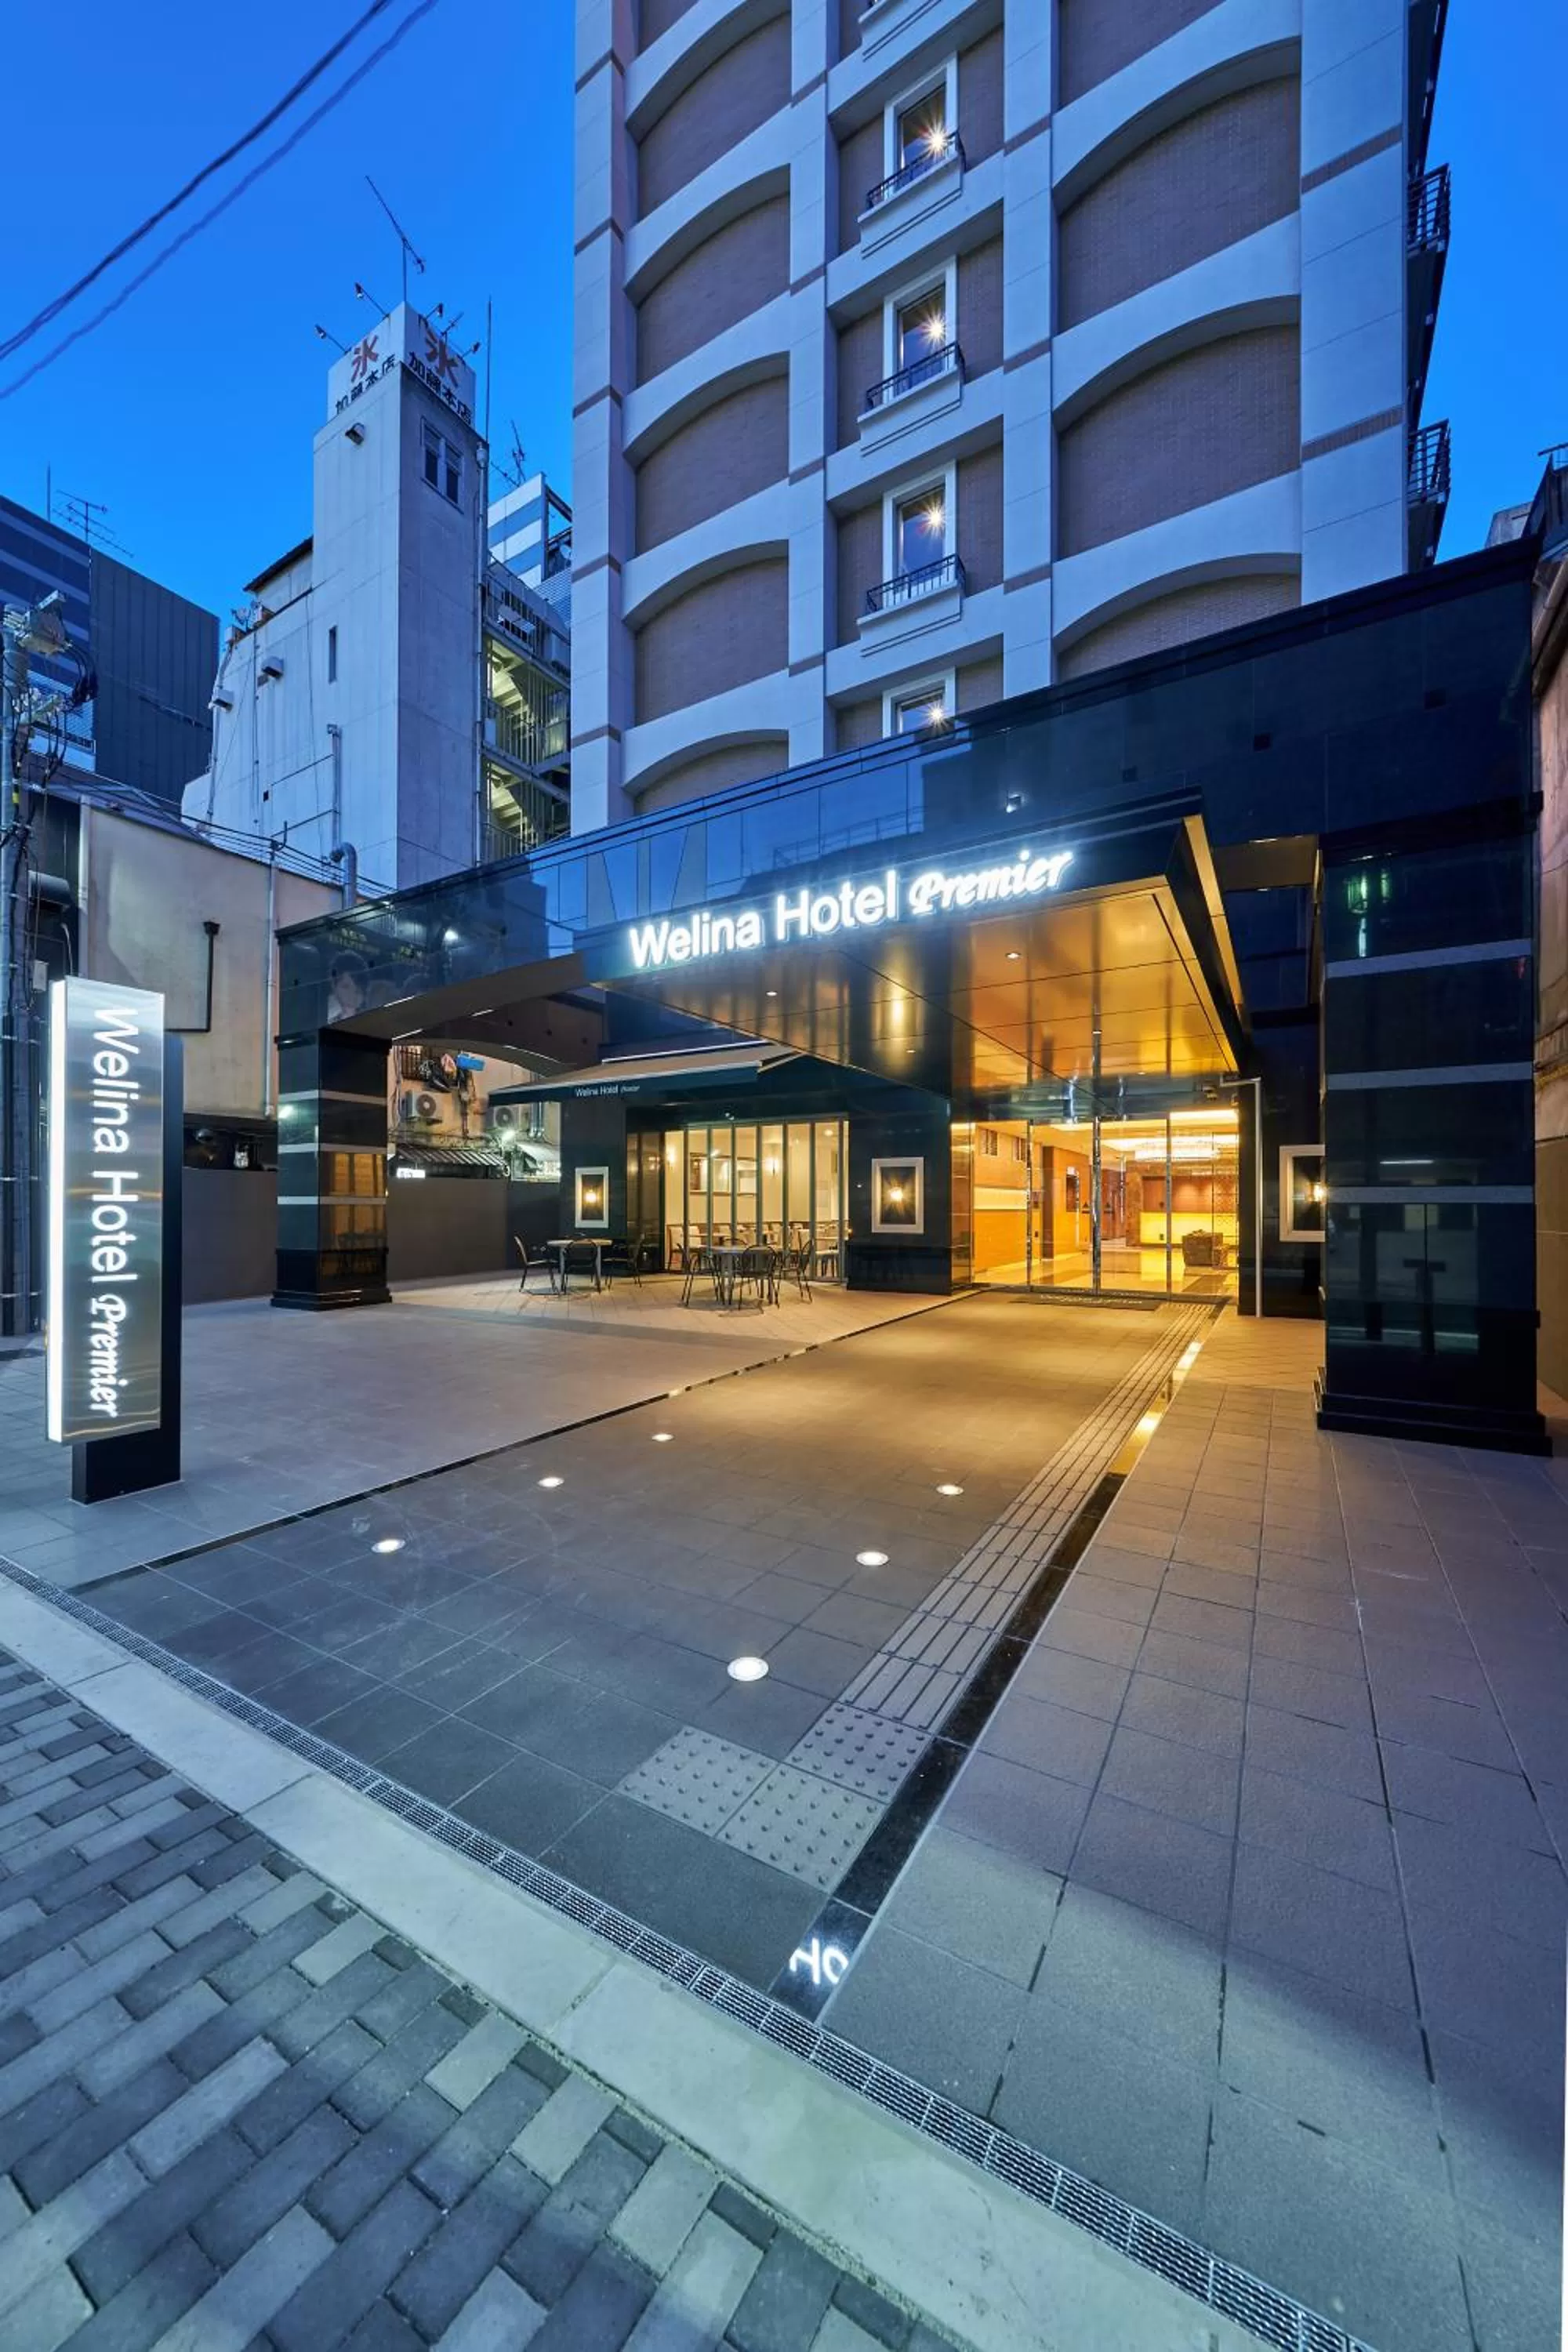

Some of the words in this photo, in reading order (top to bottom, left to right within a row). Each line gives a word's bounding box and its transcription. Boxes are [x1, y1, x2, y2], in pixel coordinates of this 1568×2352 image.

[350, 333, 379, 383] 氷
[629, 911, 762, 969] Welina
[775, 869, 898, 942] Hotel
[908, 848, 1074, 916] Premier
[92, 1007, 140, 1154] Welina
[90, 1171, 138, 1283] Hotel
[89, 1294, 128, 1417] Premier
